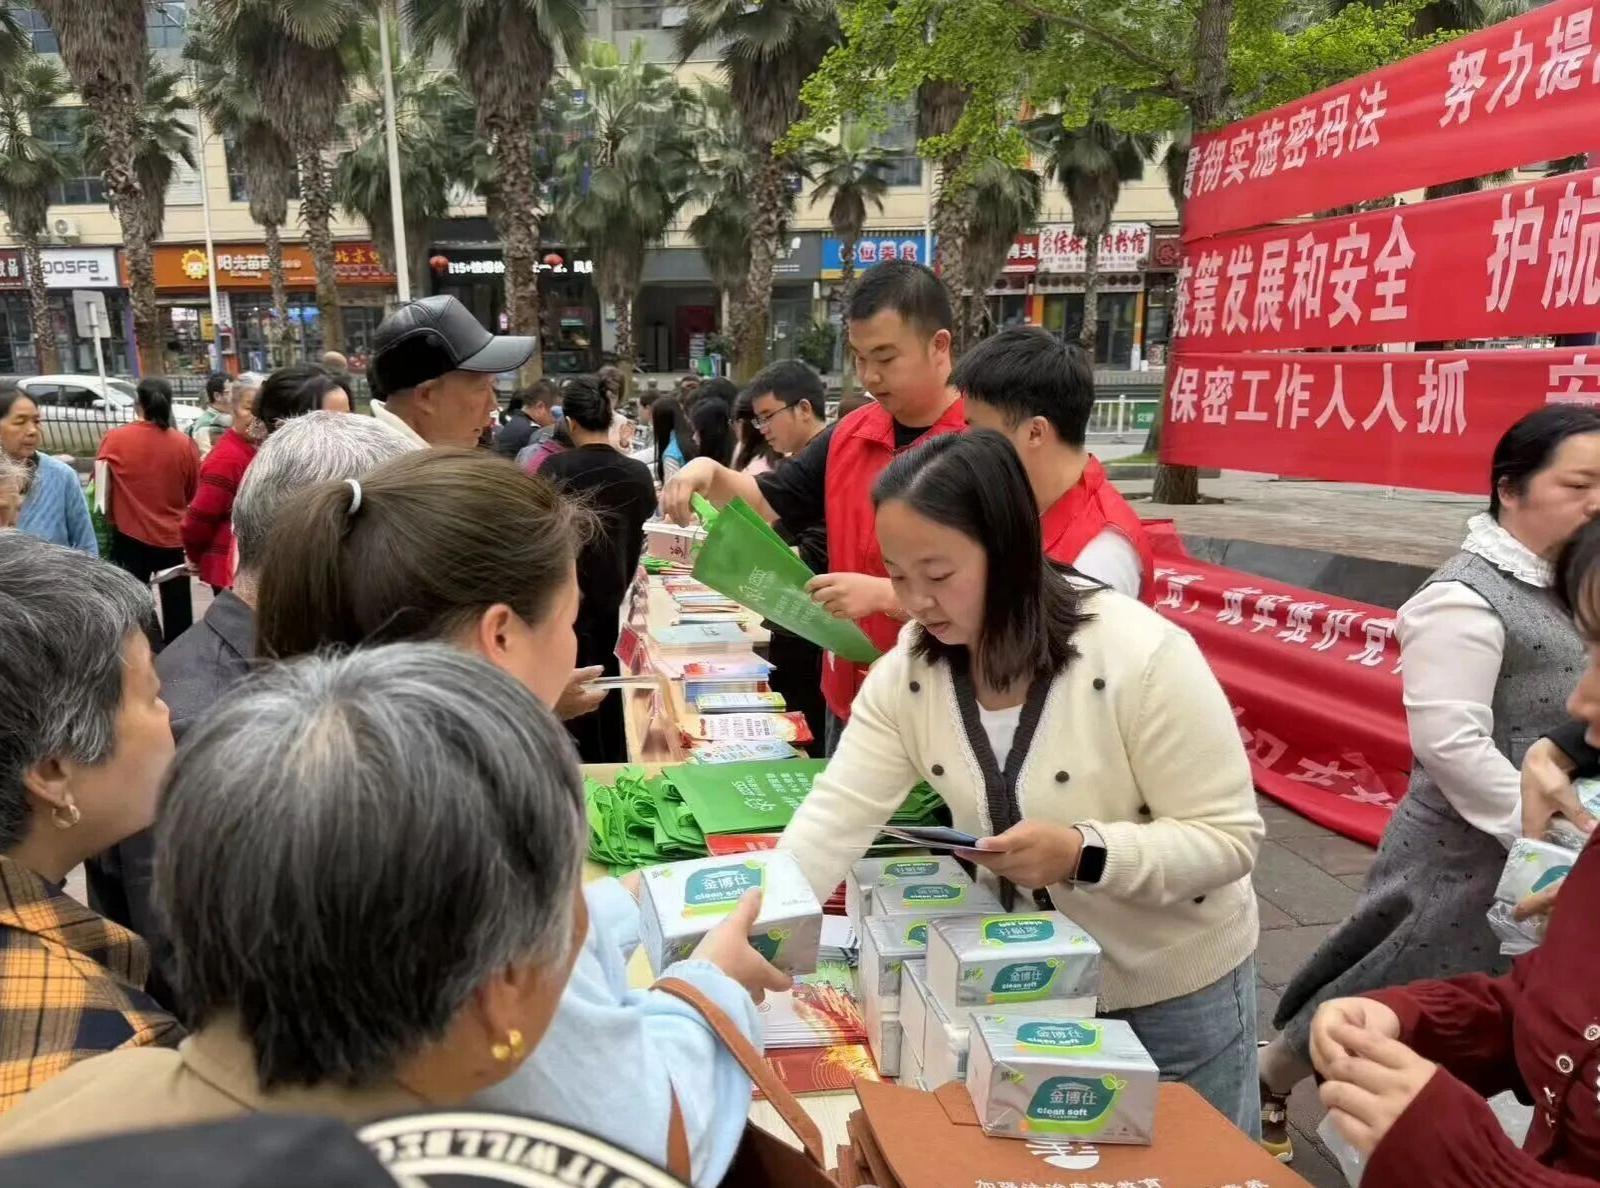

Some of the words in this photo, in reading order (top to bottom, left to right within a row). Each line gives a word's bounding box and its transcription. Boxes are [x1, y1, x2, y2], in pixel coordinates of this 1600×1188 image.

[1183, 80, 1388, 199] 贯彻实施密码法
[1439, 7, 1600, 128] 努力提
[1172, 215, 1416, 338] 统筹发展和安全
[1486, 181, 1600, 312] 护航
[1169, 358, 1468, 435] 保密工作人人抓
[1037, 1107, 1065, 1116] clean
[1067, 1108, 1088, 1116] soft
